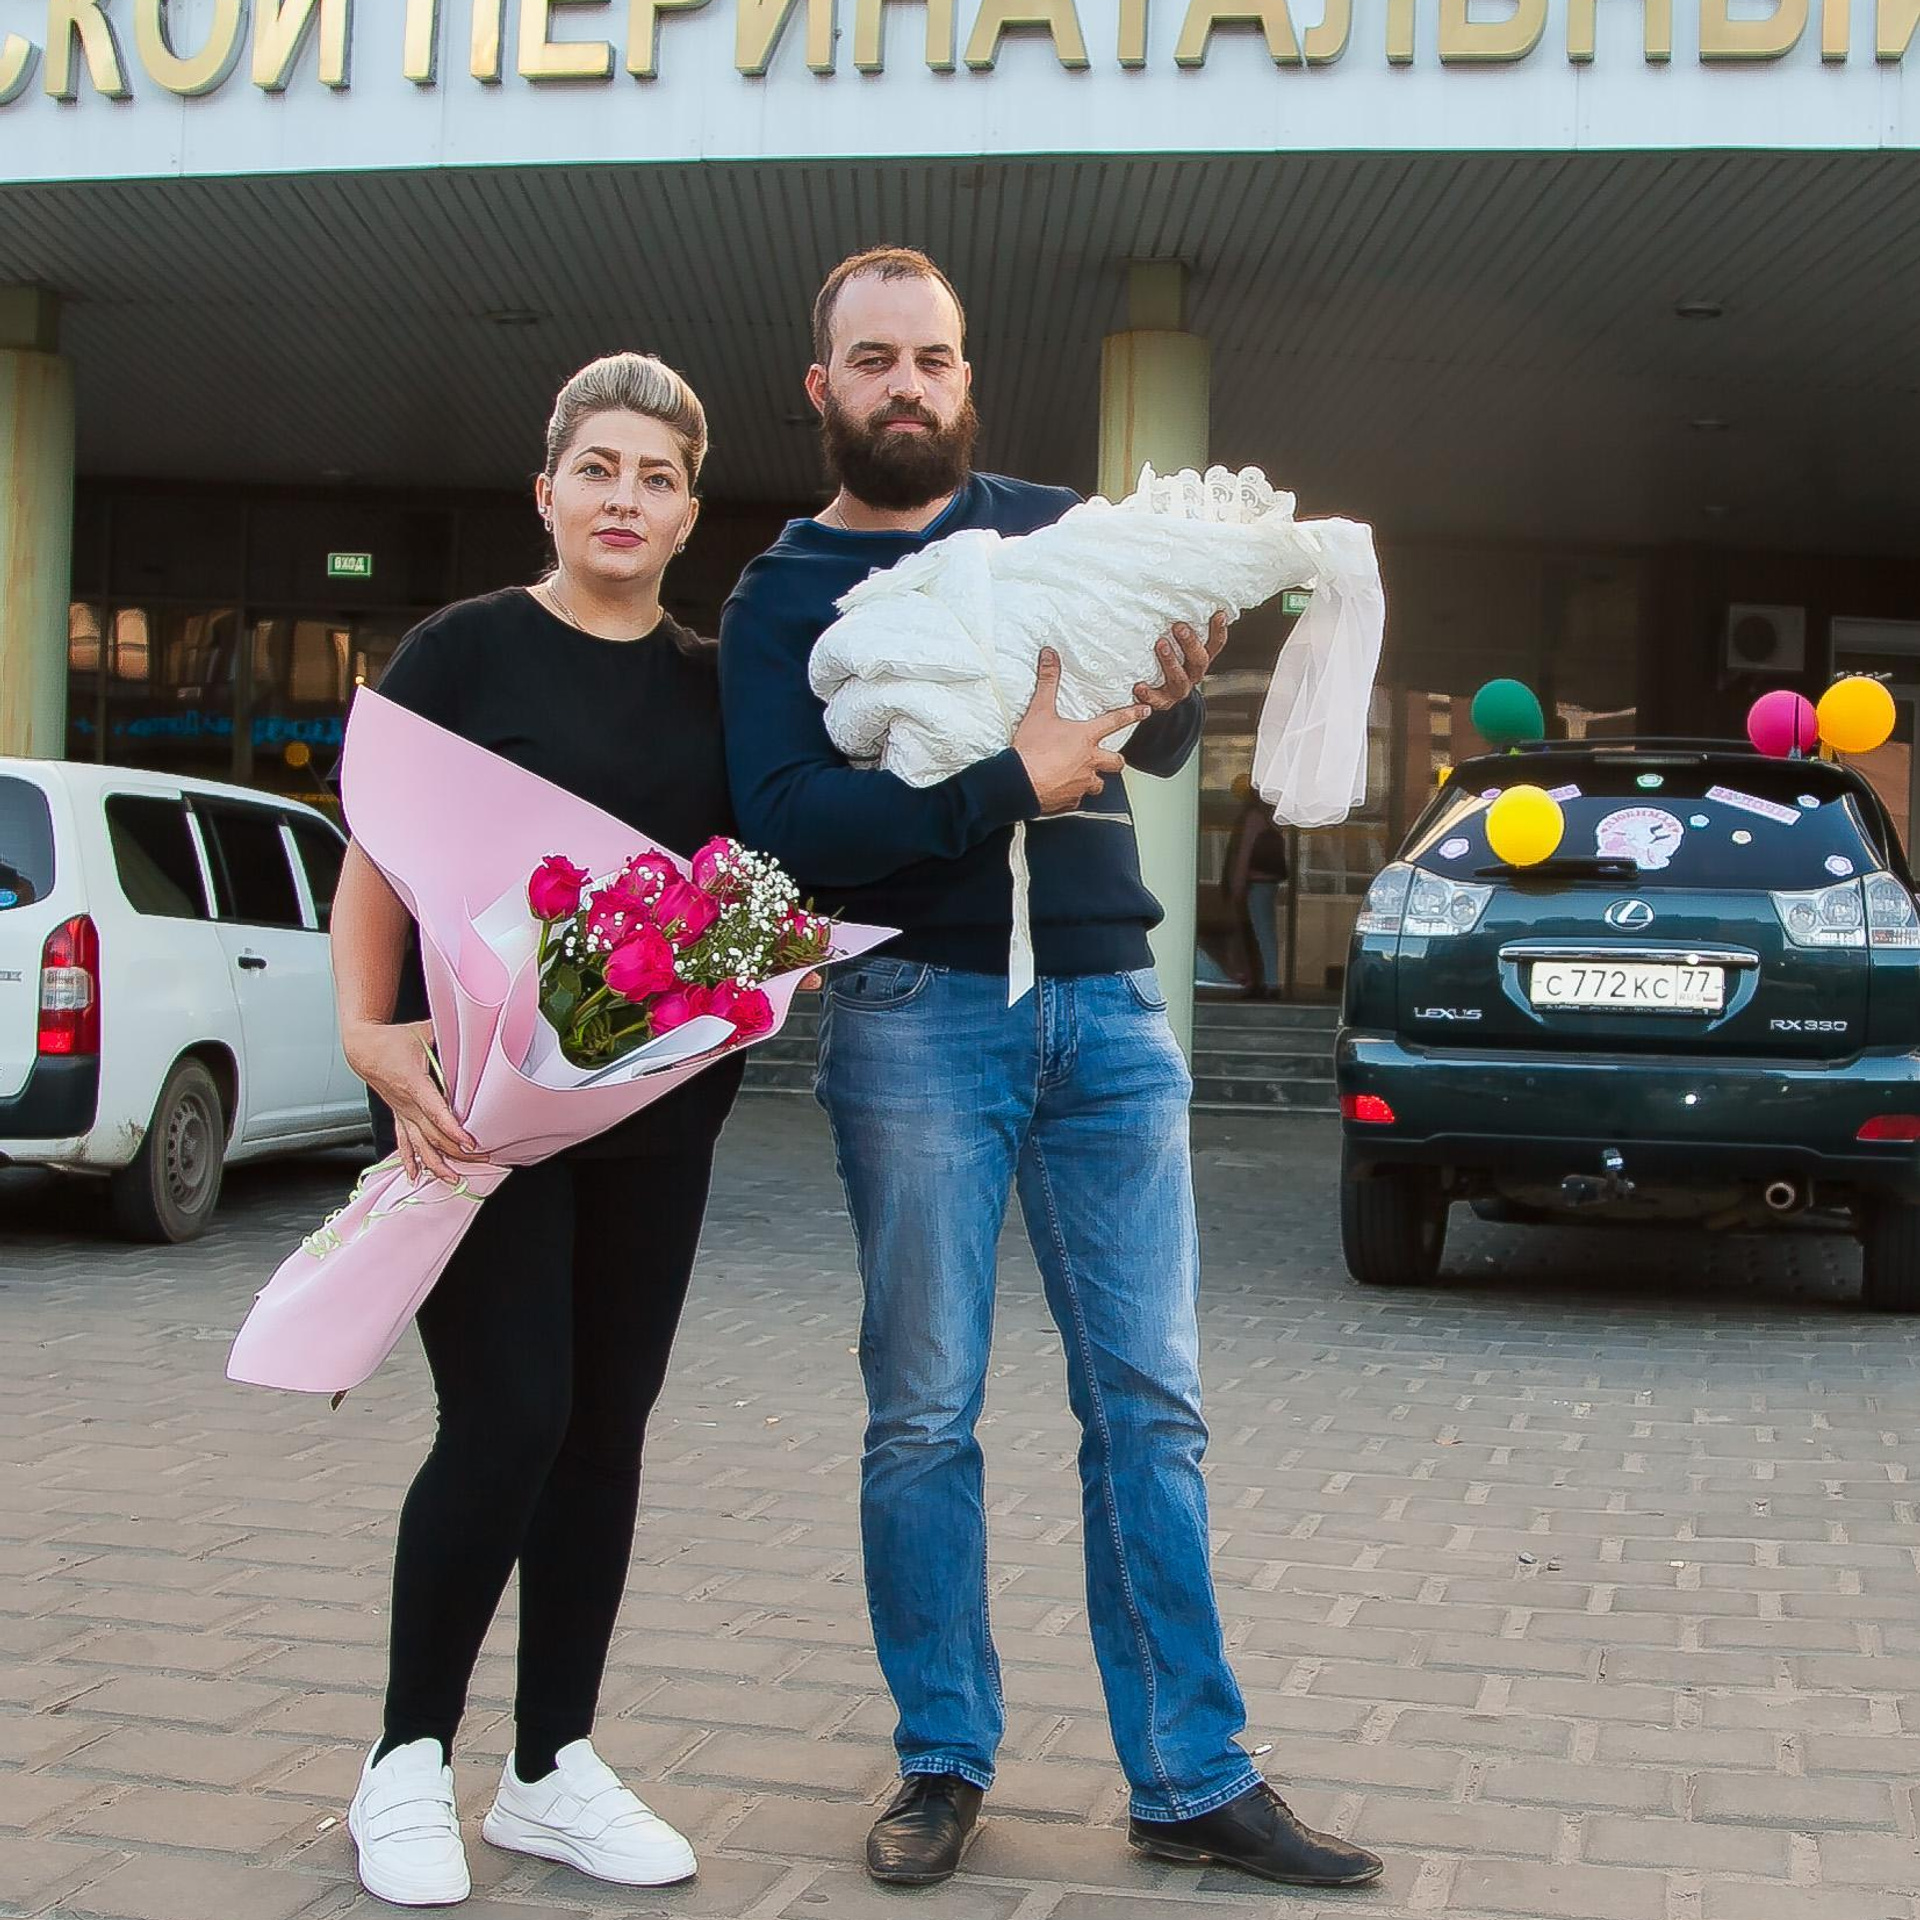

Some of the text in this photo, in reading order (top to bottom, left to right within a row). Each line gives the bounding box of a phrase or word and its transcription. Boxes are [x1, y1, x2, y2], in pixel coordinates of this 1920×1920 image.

[0, 0, 351, 100] КОЙ
[1682, 970, 1710, 993] 77
[1413, 1007, 1483, 1020] LEXUS
